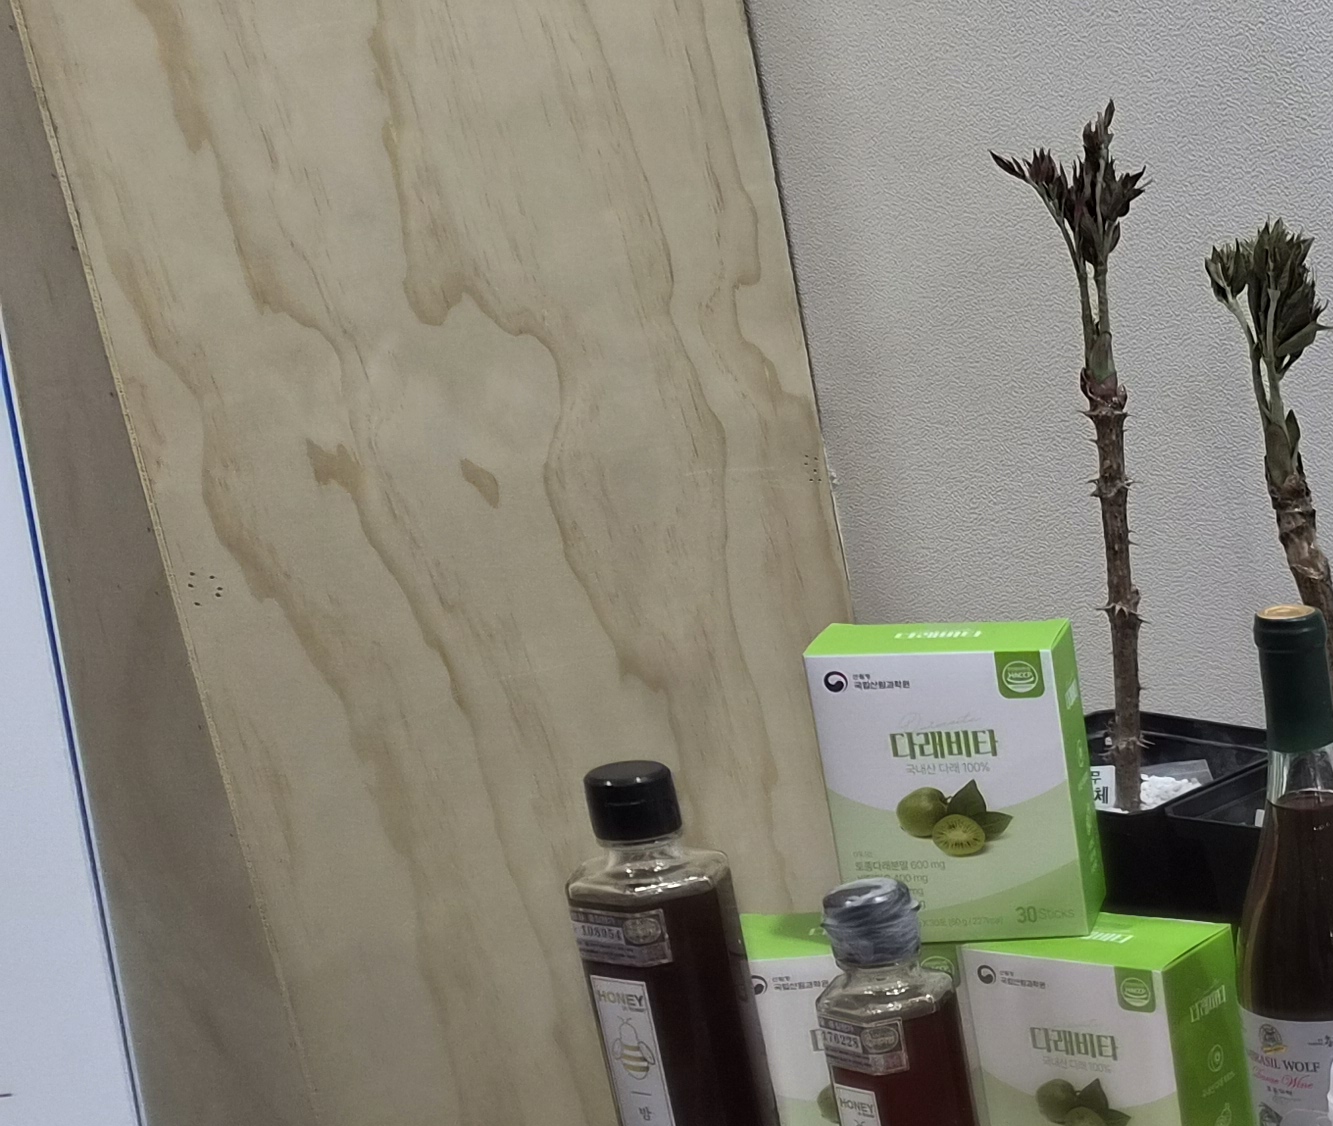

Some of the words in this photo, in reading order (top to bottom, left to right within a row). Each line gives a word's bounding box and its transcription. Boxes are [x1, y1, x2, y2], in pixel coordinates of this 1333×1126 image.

[889, 728, 998, 760] 다래비타
[939, 762, 960, 775] 다래
[962, 761, 990, 773] 100%
[1015, 905, 1038, 924] 30
[597, 990, 645, 1008] HONEY
[1029, 1026, 1119, 1061] 다래비타
[1282, 1059, 1321, 1074] WOLF
[838, 1096, 875, 1116] HONEY
